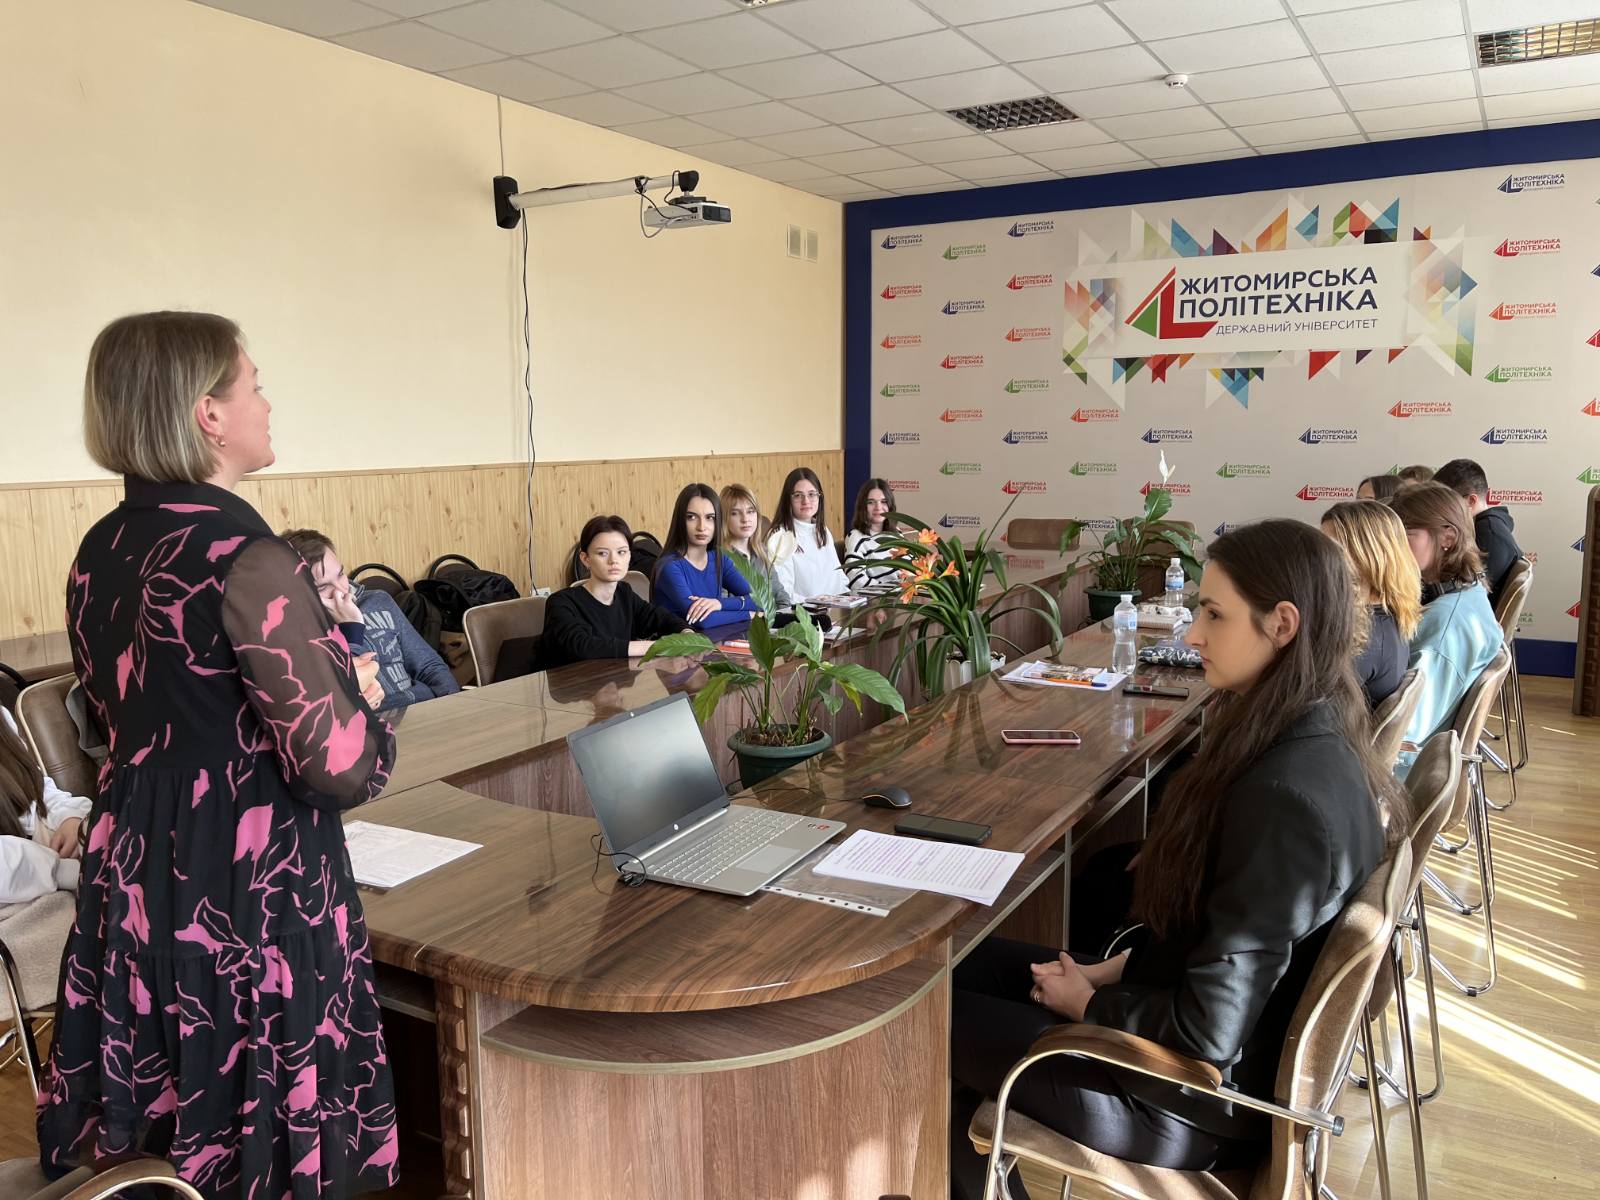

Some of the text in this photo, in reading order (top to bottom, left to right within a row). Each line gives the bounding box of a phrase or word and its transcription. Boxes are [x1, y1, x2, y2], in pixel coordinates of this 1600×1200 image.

[1512, 179, 1565, 187] ПОЛІТЕХНІКА
[1508, 243, 1561, 252] ПОЛІТЕХНІКА
[1180, 267, 1378, 295] ЖИТОМИРСЬКА
[1179, 289, 1377, 319] ПОЛІТЕХНІКА
[1216, 318, 1378, 336] ДЕРЖАВНИЙ УНІВЕРСИТЕТ
